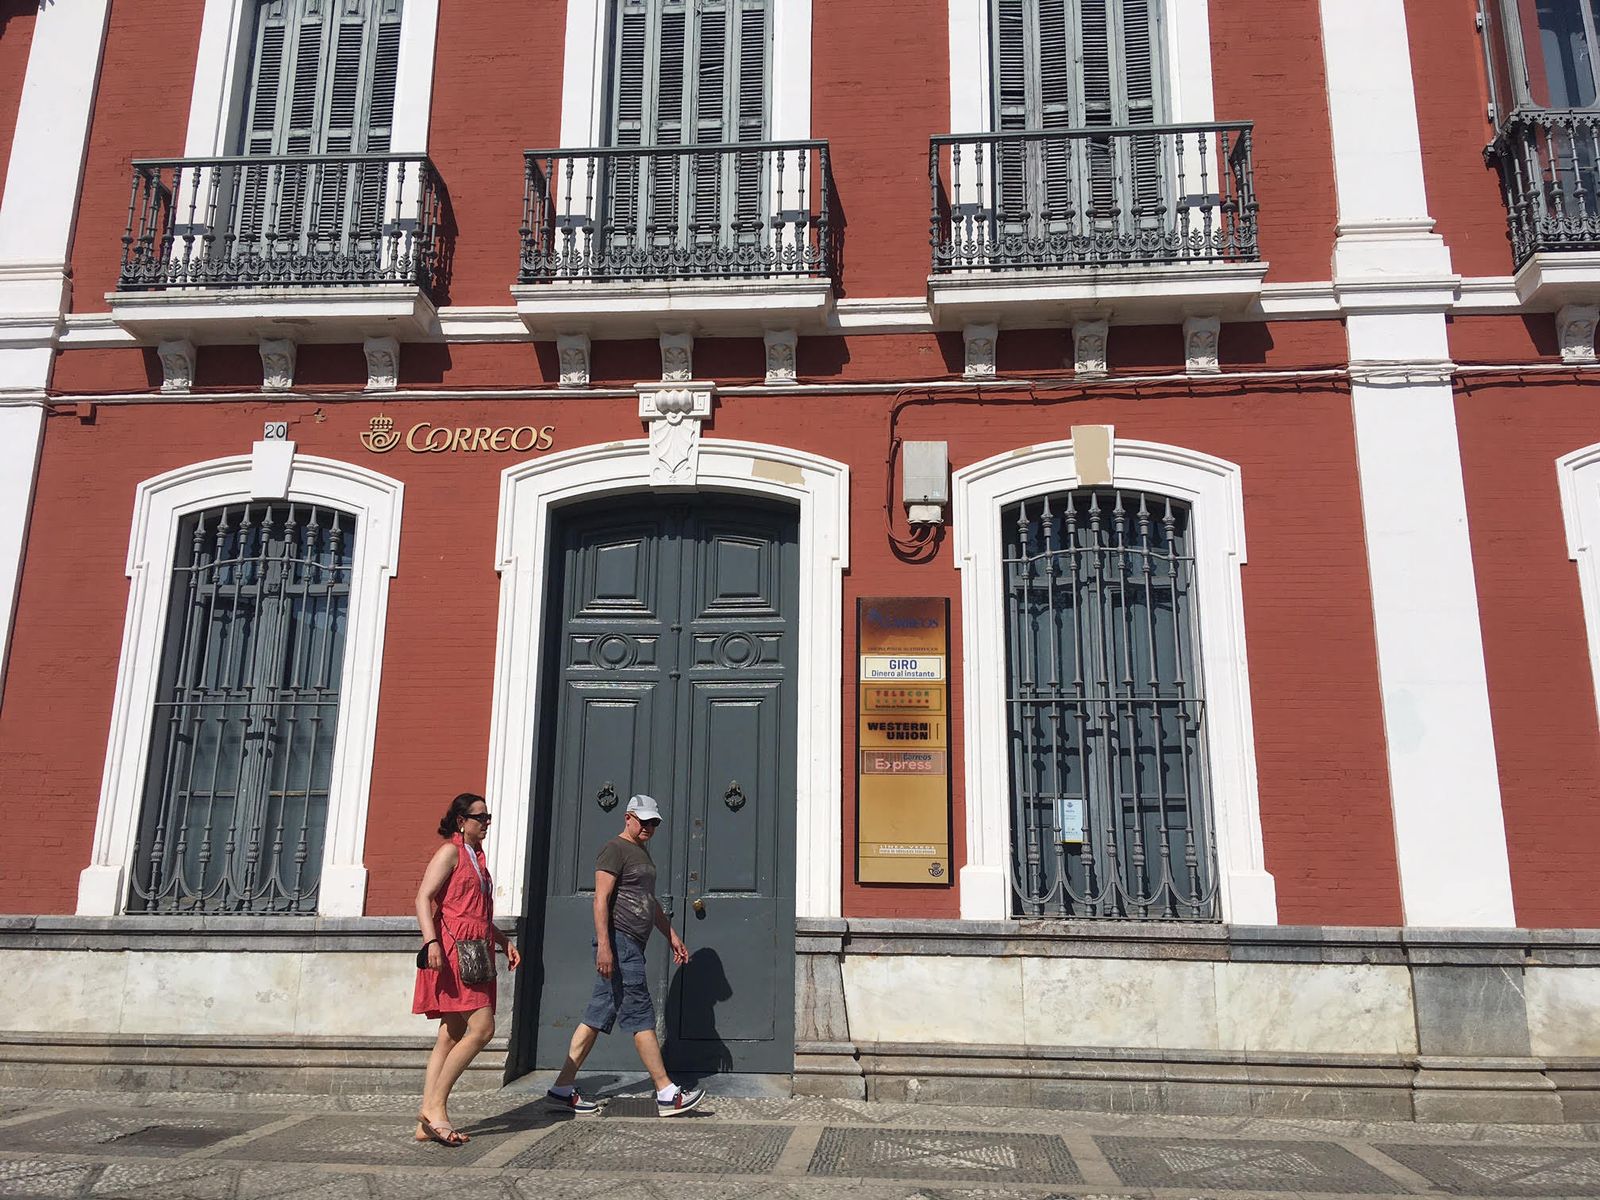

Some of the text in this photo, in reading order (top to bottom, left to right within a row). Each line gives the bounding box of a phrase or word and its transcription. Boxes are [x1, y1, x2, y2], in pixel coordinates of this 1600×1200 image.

[264, 424, 286, 439] 20
[405, 421, 555, 453] CORREOS
[889, 659, 917, 670] GIRO
[867, 722, 928, 731] WESTERN
[886, 731, 928, 740] UNION
[875, 758, 932, 772] Express
